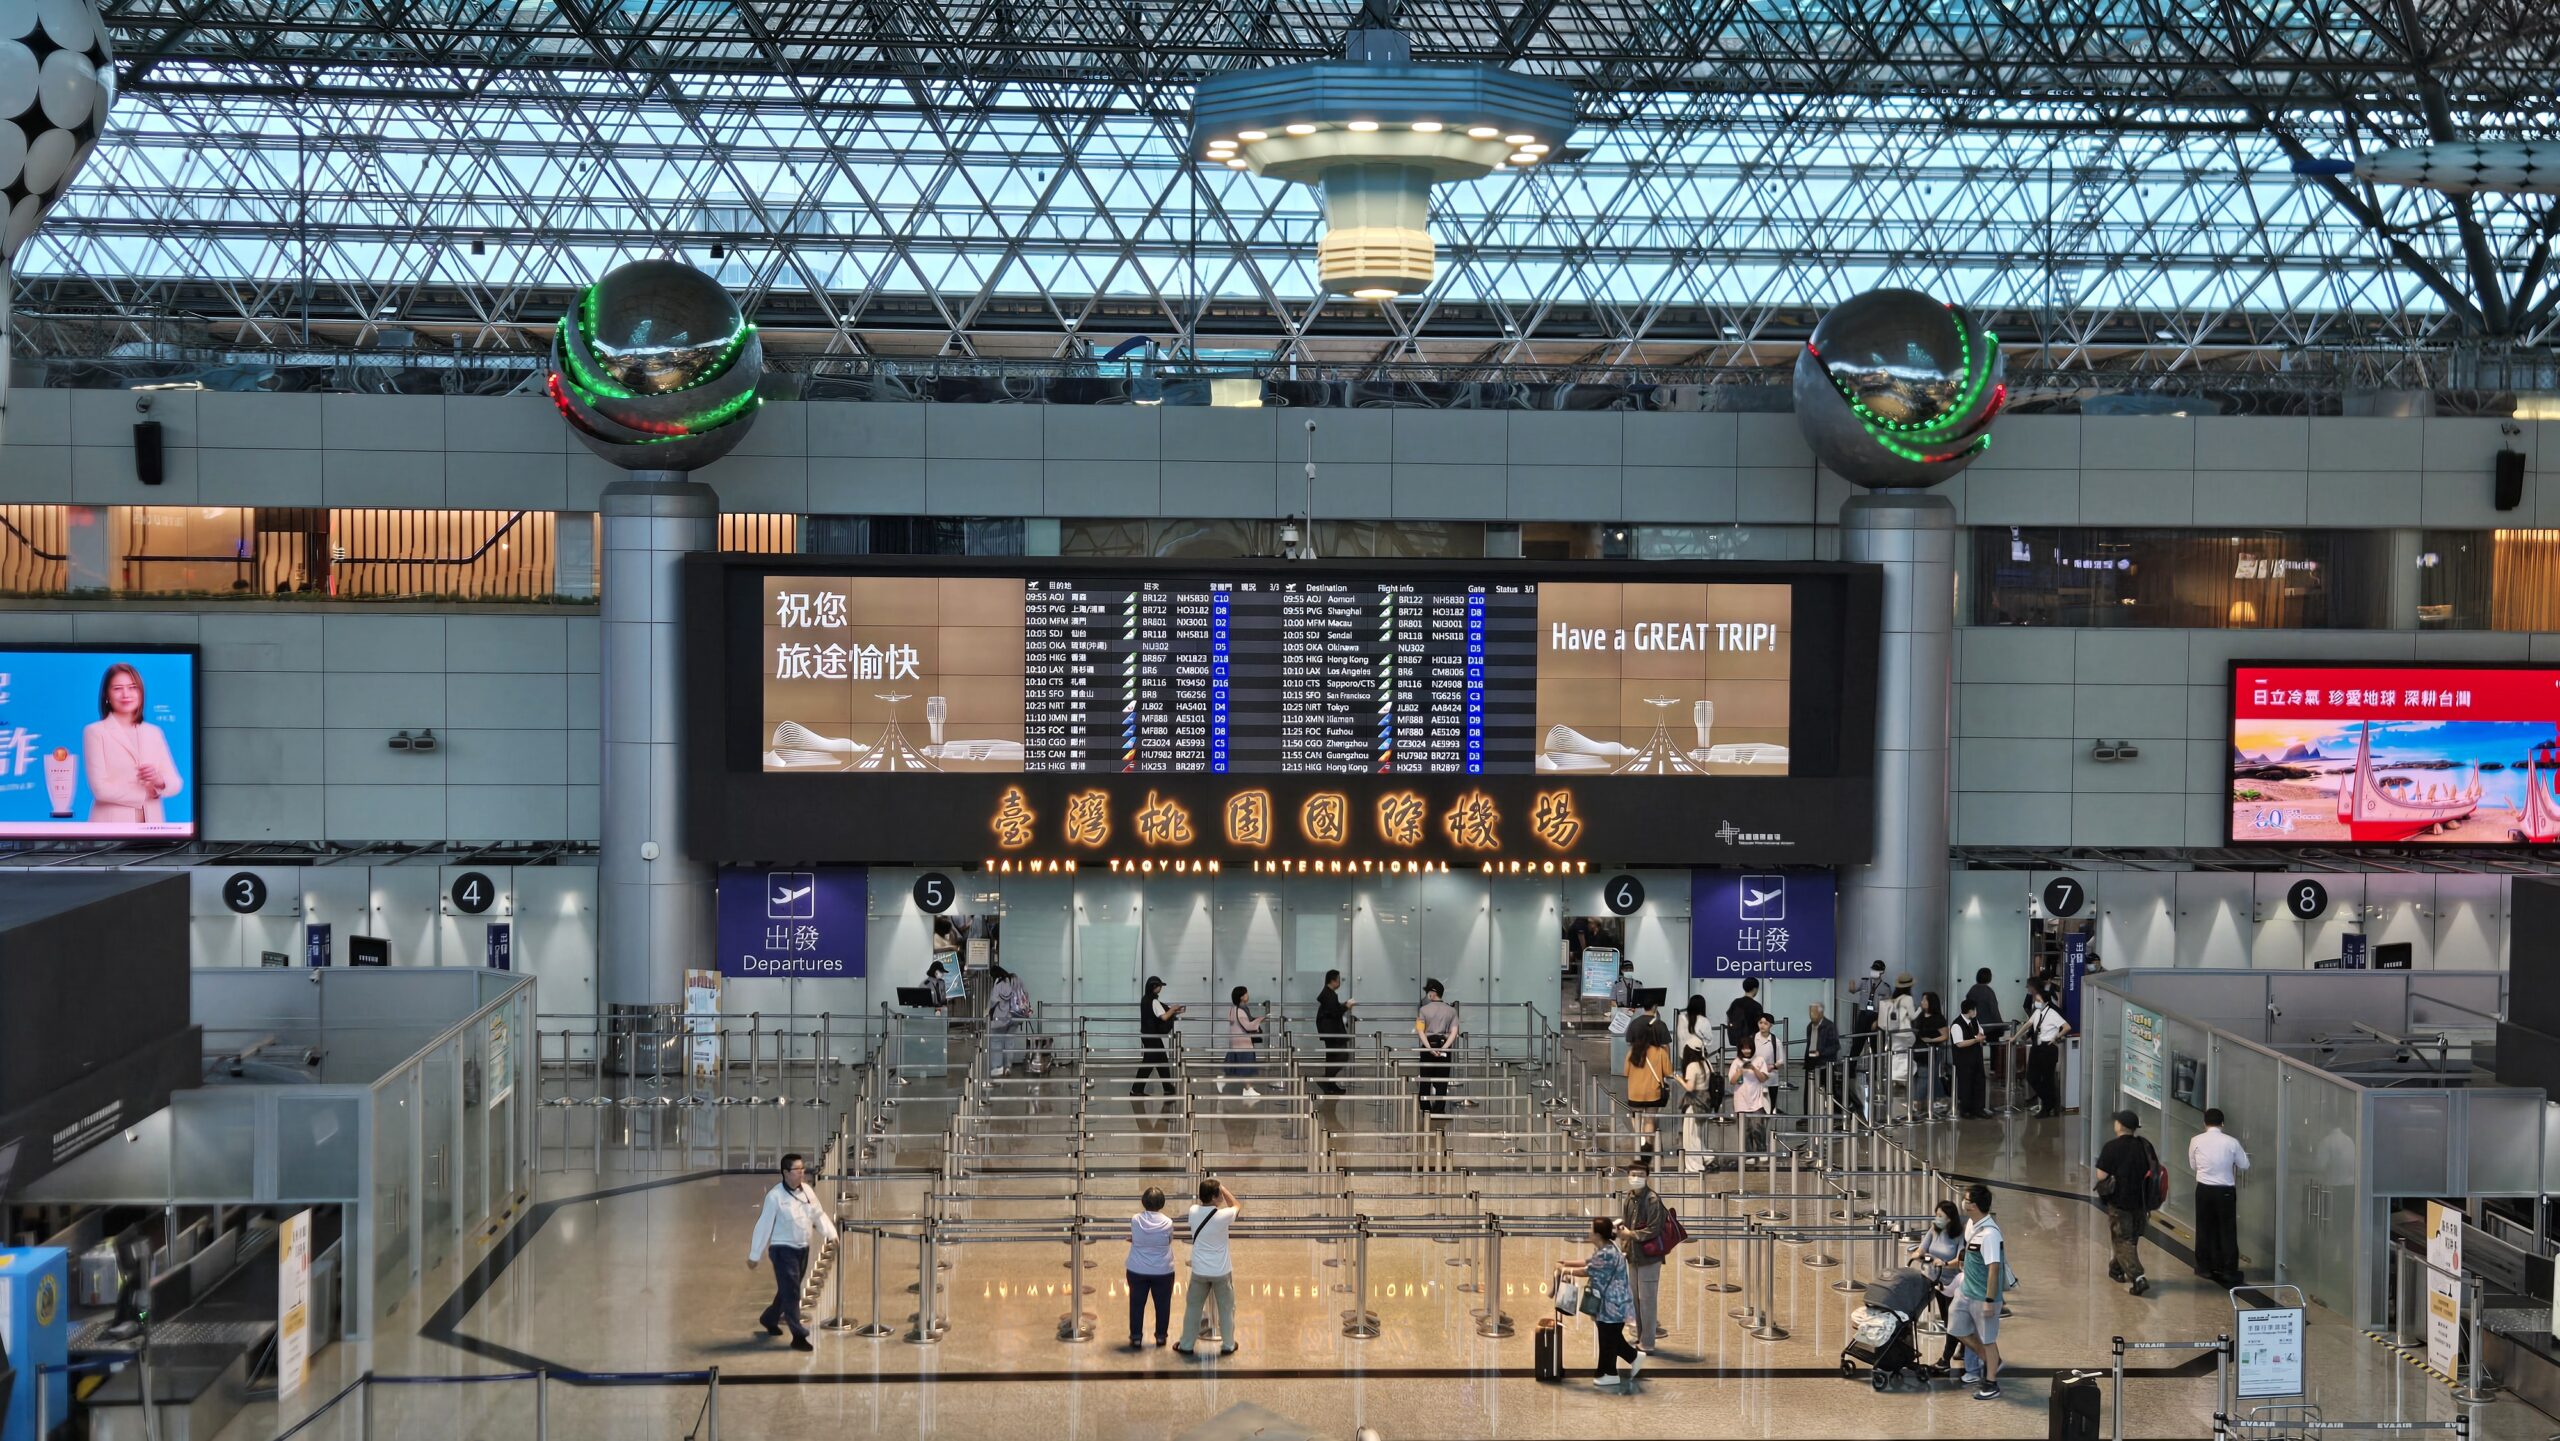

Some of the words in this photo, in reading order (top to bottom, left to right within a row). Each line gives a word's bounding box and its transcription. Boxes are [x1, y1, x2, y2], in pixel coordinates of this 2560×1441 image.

[1306, 583, 1347, 592] Destination
[1378, 584, 1398, 593] Flight
[1399, 584, 1414, 593] info
[1468, 584, 1485, 593] Gate
[1495, 584, 1518, 593] Status
[1025, 592, 1047, 601] 09:55
[1048, 592, 1065, 601] AOJ
[1142, 593, 1167, 602] BR122
[1176, 594, 1210, 603] NH5830
[1213, 594, 1230, 603] C10
[1327, 594, 1356, 603] Aomori
[776, 591, 848, 628] 祝您
[1025, 604, 1047, 613] 09:55
[1049, 604, 1066, 613] PVG
[1142, 605, 1167, 614] BR712
[1176, 606, 1209, 615] HO3182
[1215, 606, 1227, 615] D8
[1327, 606, 1362, 617] Shanghai
[1026, 616, 1048, 626] 10:00
[1049, 617, 1069, 625] MFM
[1142, 617, 1167, 627] BR801
[1176, 618, 1208, 627] NX3001
[1215, 618, 1227, 627] D2
[1283, 618, 1305, 627] 10:00
[1327, 619, 1353, 628] Macau
[1025, 629, 1047, 638] 10:05
[1049, 629, 1063, 638] SDJ
[1142, 630, 1167, 639] BR118
[1176, 630, 1209, 639] NH5818
[1215, 630, 1226, 639] C8
[1283, 631, 1304, 640] 10:05
[1327, 631, 1353, 640] Sendai
[1552, 622, 1605, 651] Have
[1613, 629, 1625, 651] a
[1634, 623, 1709, 651] GREAT
[1715, 623, 1776, 651] TRIP!
[1025, 641, 1047, 650] 10:05
[1048, 641, 1067, 650] OKA
[1142, 642, 1169, 651] NU302
[1215, 643, 1227, 651] D5
[1327, 643, 1360, 652] Okinawa
[776, 643, 920, 680] 旅途愉快
[1025, 653, 1047, 662] 10:05
[1049, 653, 1067, 662] HKG
[1142, 654, 1167, 663] BR867
[1176, 654, 1207, 663] HX1823
[1212, 655, 1229, 663] D18
[1328, 655, 1348, 666] Hong
[1348, 655, 1368, 666] Kong
[1025, 665, 1047, 674] 10:10
[1048, 665, 1064, 674] LAX
[1142, 666, 1158, 675] BR6
[1215, 666, 1226, 675] C1
[1282, 667, 1304, 676] 10:10
[1328, 667, 1340, 676] Los
[1340, 667, 1370, 677] Angeles
[1025, 677, 1047, 686] 10:10
[1048, 677, 1064, 686] CTS
[1141, 678, 1167, 687] BR116
[1175, 678, 1206, 687] TK9450
[1212, 679, 1229, 688] D16
[1326, 679, 1376, 689] Sapporo/CTS
[1025, 689, 1047, 698] 10:15
[1048, 689, 1065, 698] SFO
[1141, 690, 1158, 699] BR8
[1175, 690, 1207, 699] TG6256
[1215, 690, 1226, 699] C3
[1326, 691, 1340, 699] San
[1340, 691, 1370, 699] Francisco
[2253, 689, 2320, 706] 日立冷氣
[2328, 690, 2396, 707] 珍愛地球
[1025, 701, 1047, 710] 10:25
[1048, 701, 1065, 710] NRT
[1176, 702, 1207, 711] HA5401
[1214, 702, 1226, 711] D4
[1282, 702, 1303, 712] 10:25
[1326, 702, 1350, 714] Tokyo
[1025, 713, 1047, 722] 11:10
[1048, 713, 1068, 722] XMN
[1141, 714, 1168, 723] MF888
[1175, 714, 1206, 723] AE5101
[1214, 714, 1226, 723] D9
[1282, 714, 1304, 724] 11:10
[1025, 726, 1047, 735] 11:25
[1048, 725, 1065, 734] FOC
[1141, 726, 1168, 735] MF880
[1175, 726, 1206, 736] AE5109
[1214, 727, 1226, 736] D8
[1326, 727, 1354, 736] Fuzhou
[1025, 738, 1047, 747] 11:50
[1048, 738, 1067, 747] CGO
[1141, 738, 1171, 747] CZ3024
[1175, 738, 1206, 747] AE5993
[1214, 739, 1226, 748] C5
[1326, 739, 1369, 749] Zhengzhou
[1025, 750, 1046, 759] 11:55
[1047, 750, 1066, 758] CAN
[1175, 750, 1206, 759] BR2721
[1214, 751, 1226, 759] D3
[1326, 751, 1369, 761] Guangzhou
[1025, 762, 1046, 771] 12:15
[1048, 762, 1066, 770] HKG
[1175, 762, 1206, 771] BR2897
[1326, 763, 1346, 774] Hong
[1348, 763, 1368, 774] Kong
[990, 785, 1583, 850] 臺灣桃園國際機場
[985, 859, 1077, 873] TAIWAN
[1109, 859, 1221, 873] TAOYUAN
[1253, 860, 1450, 874] INTERNATIONAL
[1482, 860, 1589, 875] AIRPORT
[236, 880, 255, 907] 3
[462, 880, 481, 906] 4
[926, 881, 942, 906] 5
[1616, 883, 1633, 908] 6
[2057, 885, 2072, 909] 7
[2300, 887, 2315, 912] 8
[765, 924, 819, 952] 出發
[1737, 926, 1790, 953] 出發
[743, 953, 843, 976] Departures
[1715, 955, 1813, 977] Departures
